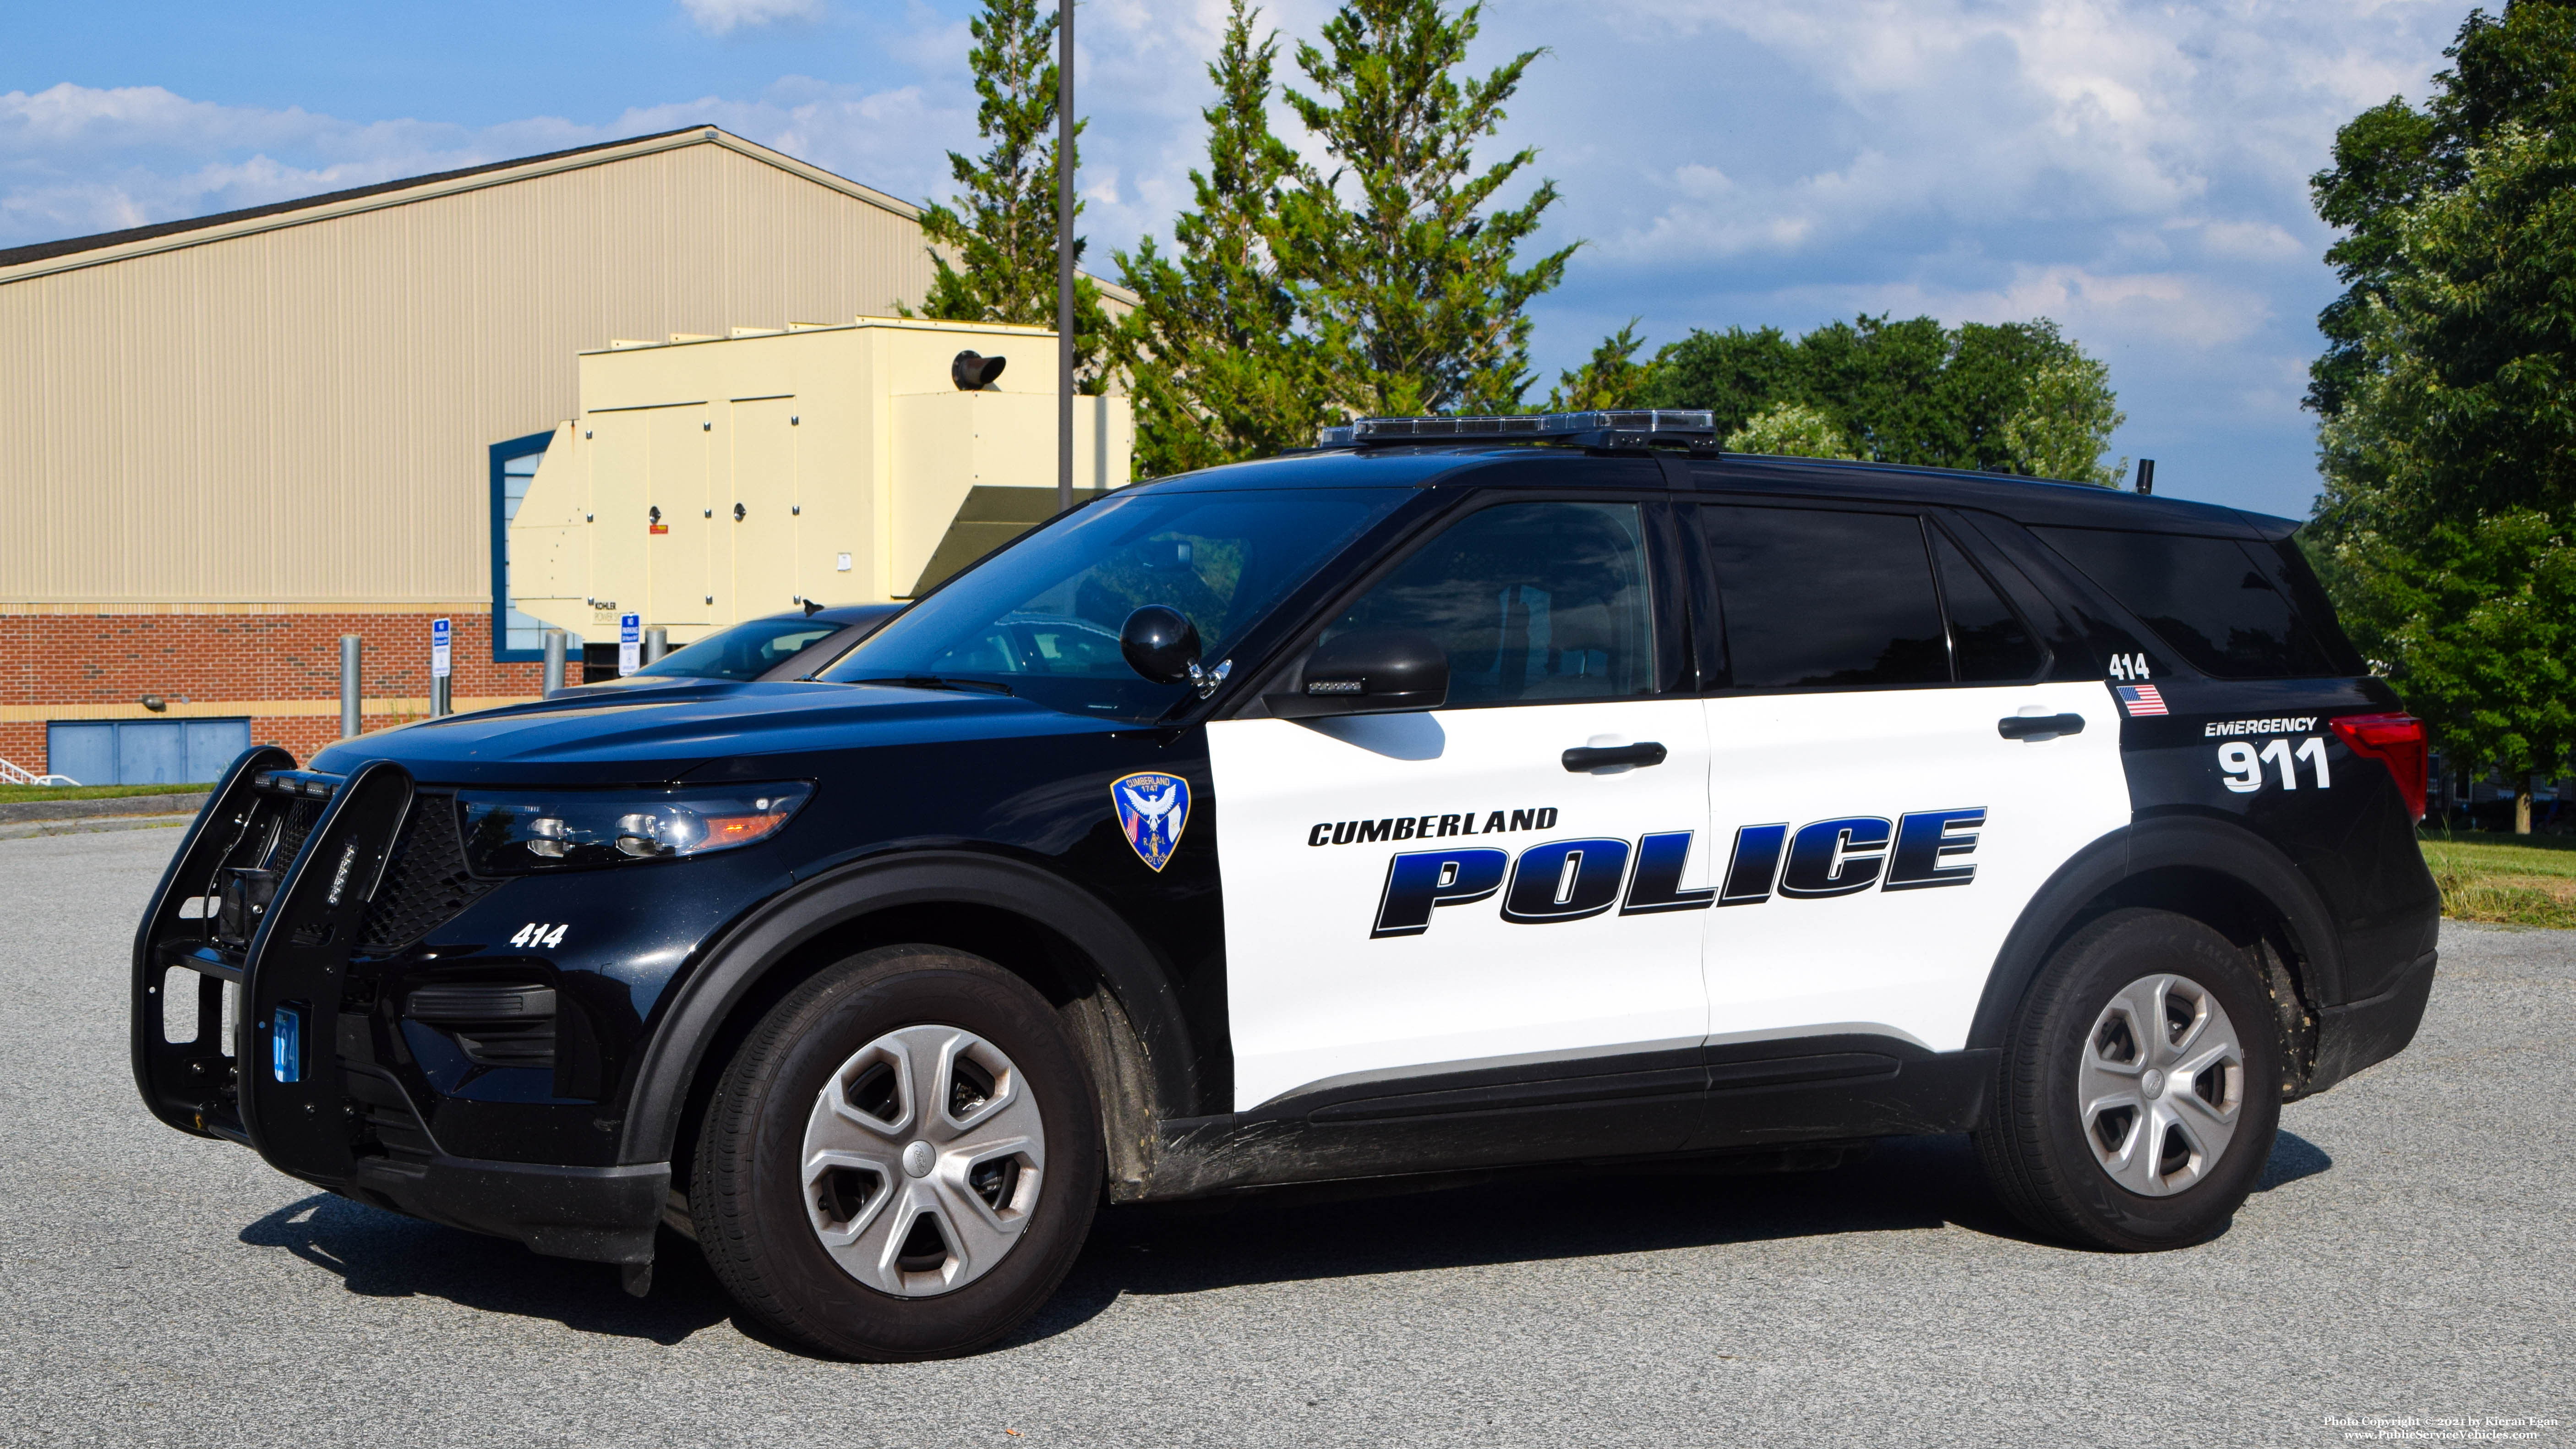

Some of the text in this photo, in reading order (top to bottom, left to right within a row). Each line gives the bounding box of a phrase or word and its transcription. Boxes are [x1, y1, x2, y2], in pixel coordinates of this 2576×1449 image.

[2109, 653, 2150, 680] 414
[2205, 717, 2318, 737] EMERGENCY
[2218, 737, 2330, 793] 911
[1125, 776, 1170, 788] CUMBERLAND
[1308, 807, 1558, 847] CUMBERLAND
[1145, 852, 1167, 865] POLICE
[1369, 806, 1987, 940] POLICE
[510, 923, 569, 948] 414
